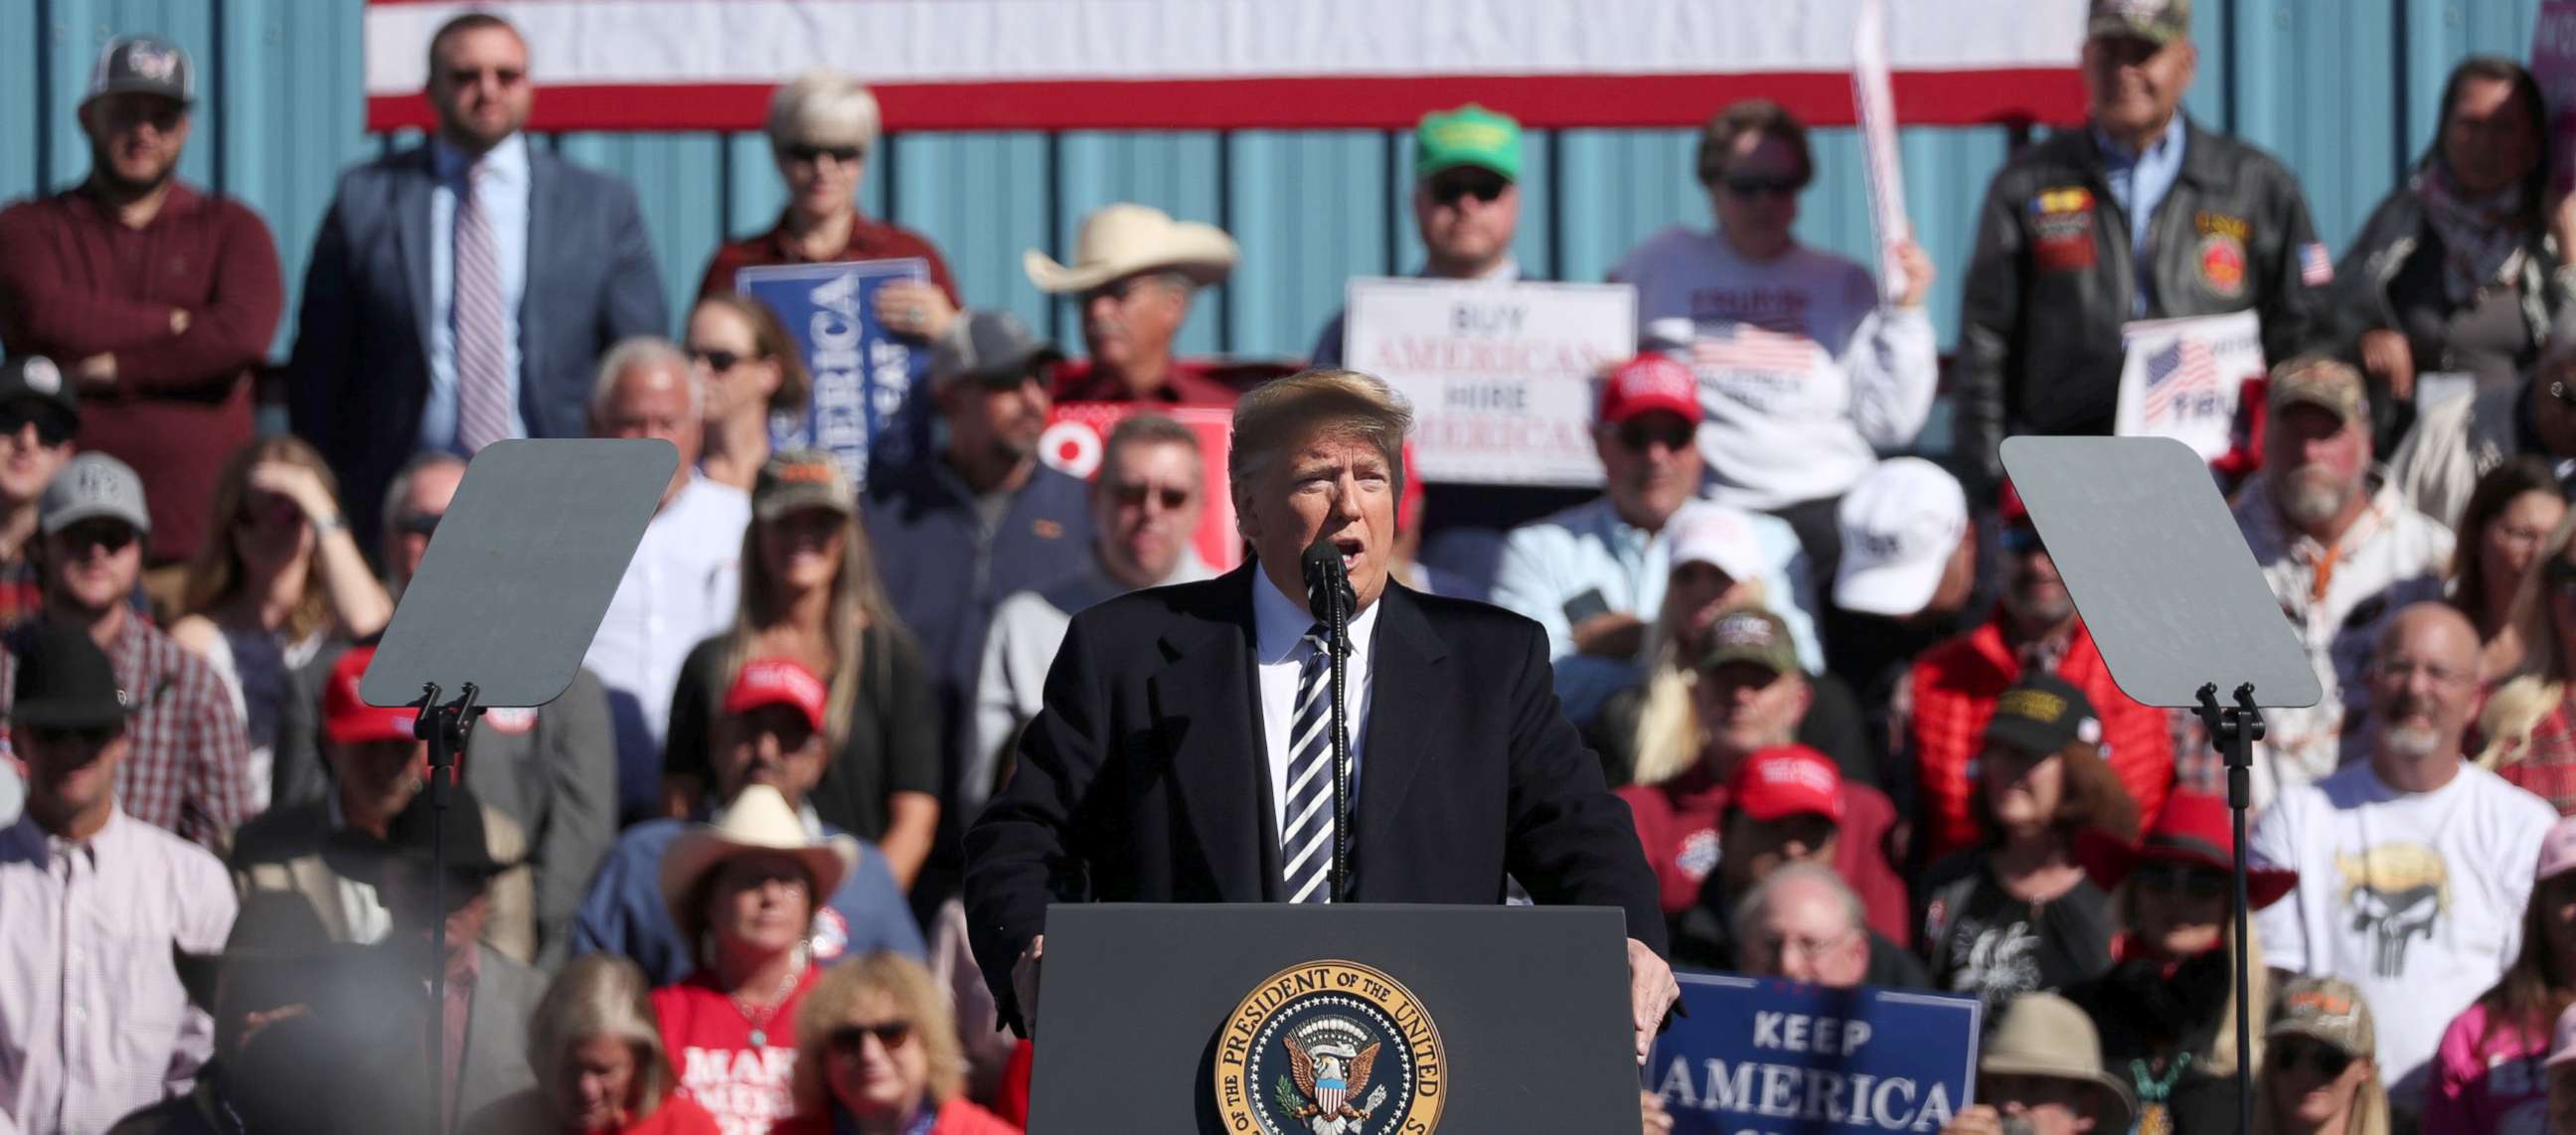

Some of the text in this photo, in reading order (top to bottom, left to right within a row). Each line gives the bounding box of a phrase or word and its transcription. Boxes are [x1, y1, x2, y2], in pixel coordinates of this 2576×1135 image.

[1450, 301, 1528, 334] BUY
[1445, 383, 1528, 409] HIRE
[1222, 968, 1438, 1131] OF THE PRESIDENT OF THE UNITED
[1753, 1010, 1872, 1055] KEEP
[1657, 1054, 1958, 1133] AMERICA
